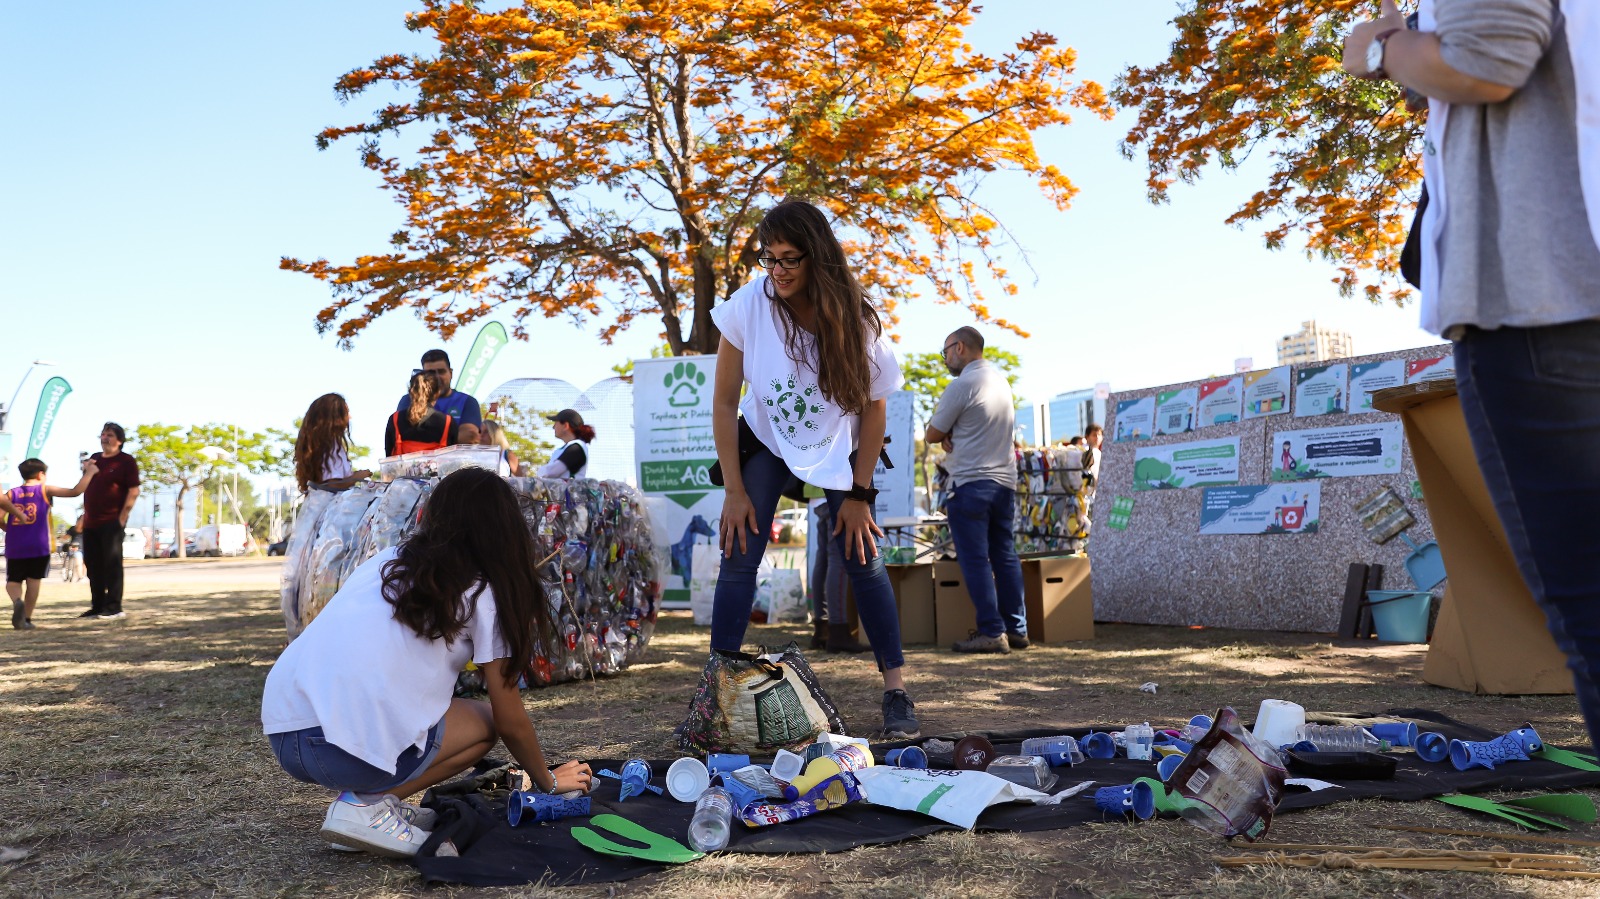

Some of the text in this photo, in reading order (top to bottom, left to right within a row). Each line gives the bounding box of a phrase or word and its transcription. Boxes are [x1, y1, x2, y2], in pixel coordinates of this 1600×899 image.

[463, 333, 499, 394] rotegé
[687, 431, 714, 444] tapit
[680, 464, 713, 487] AQ
